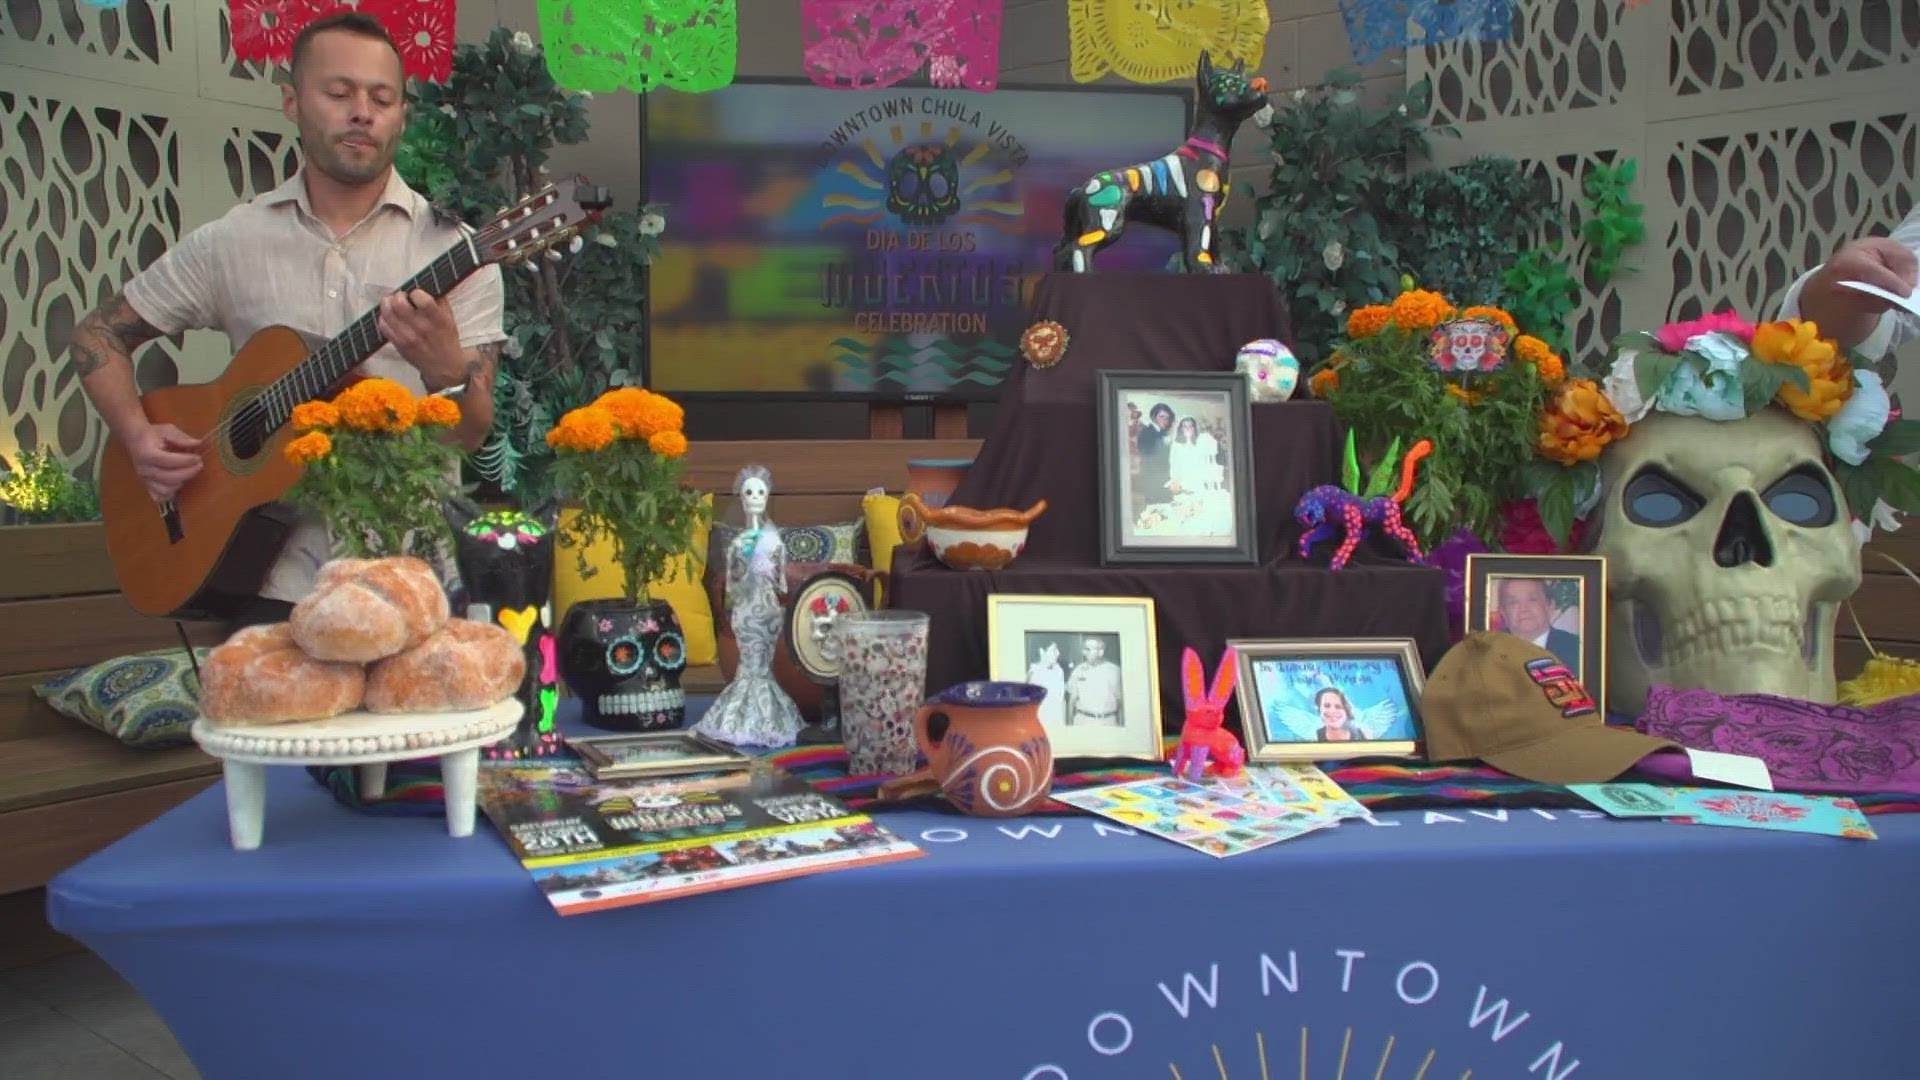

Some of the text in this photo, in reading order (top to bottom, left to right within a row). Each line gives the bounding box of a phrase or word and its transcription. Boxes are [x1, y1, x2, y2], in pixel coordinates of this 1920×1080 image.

[921, 97, 981, 128] CHULA
[987, 120, 1029, 167] VISTA
[908, 231, 929, 251] DE
[937, 231, 976, 252] LOS
[855, 313, 987, 333] CELEBRATION
